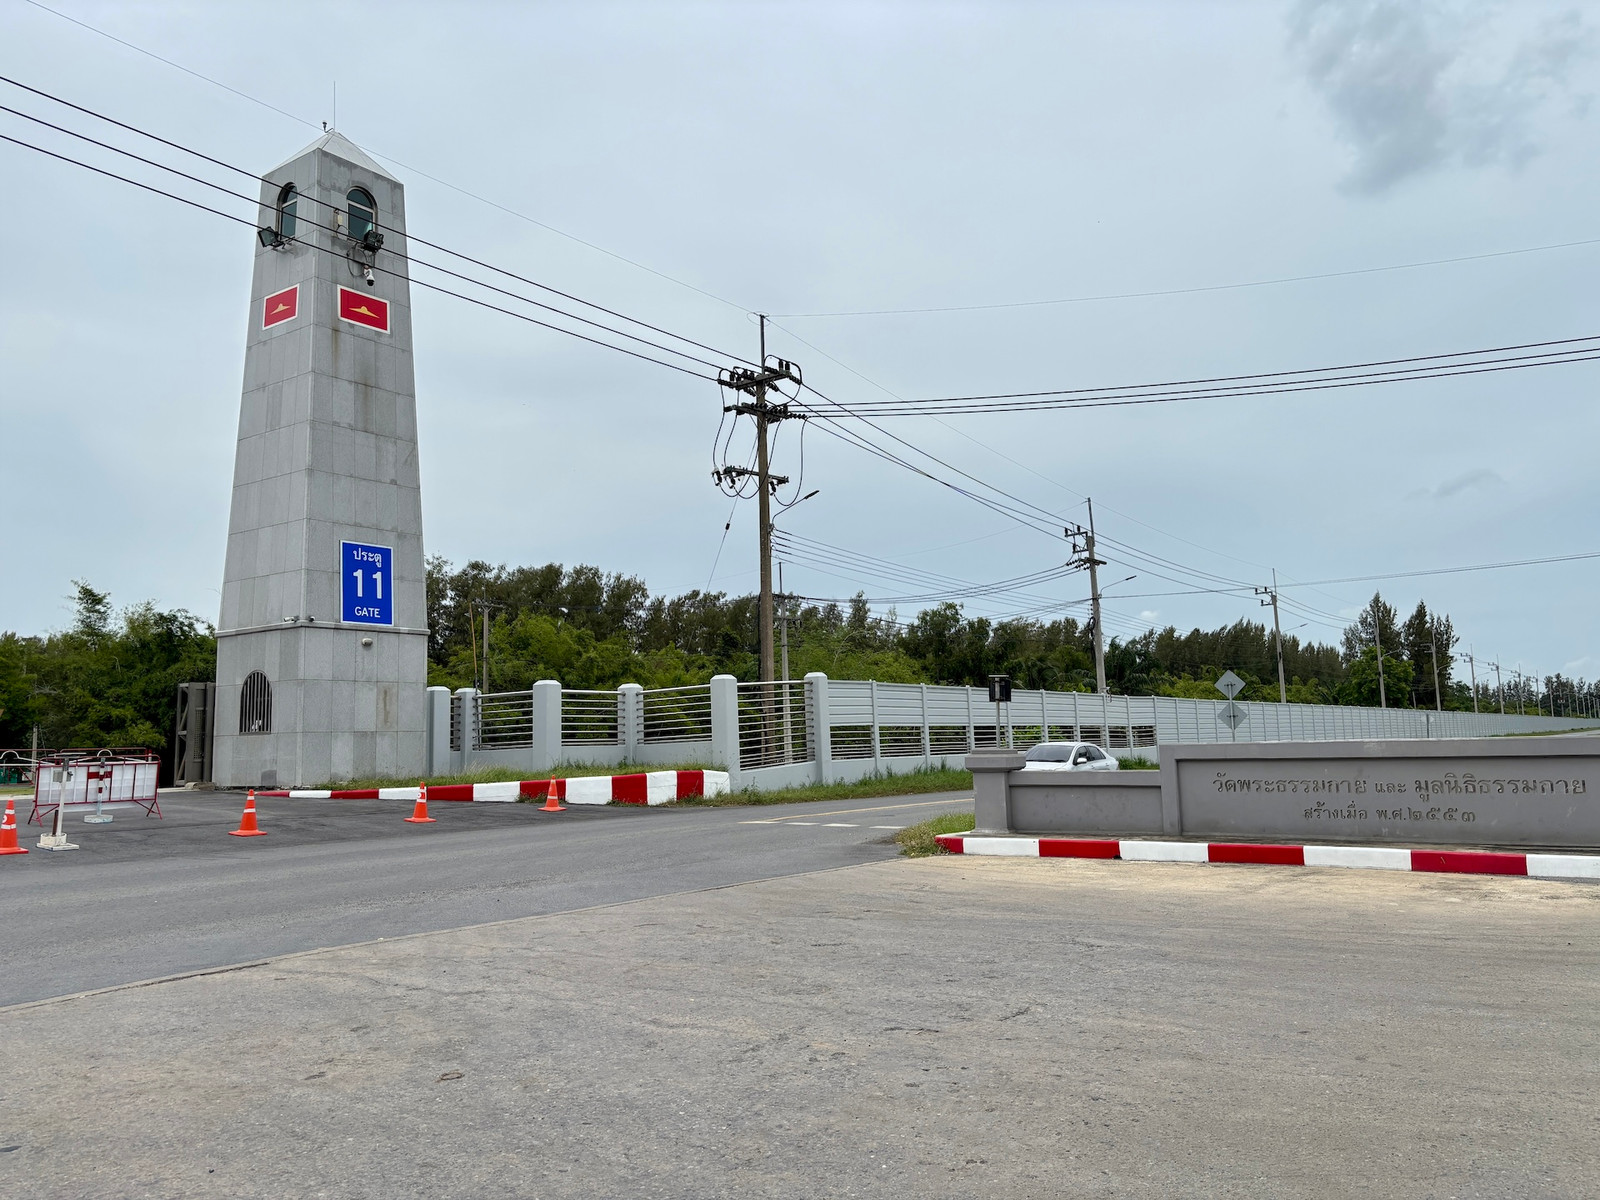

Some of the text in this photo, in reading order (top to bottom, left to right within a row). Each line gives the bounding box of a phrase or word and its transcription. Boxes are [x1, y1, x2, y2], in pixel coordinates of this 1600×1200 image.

[353, 547, 382, 568] ประตู
[353, 569, 382, 599] 11
[354, 606, 381, 618] GATE
[1213, 772, 1587, 802] วัดพระธรรมกาย และ มูลนิธิธรรมกาย
[1304, 801, 1368, 820] สร้างเมื่อ
